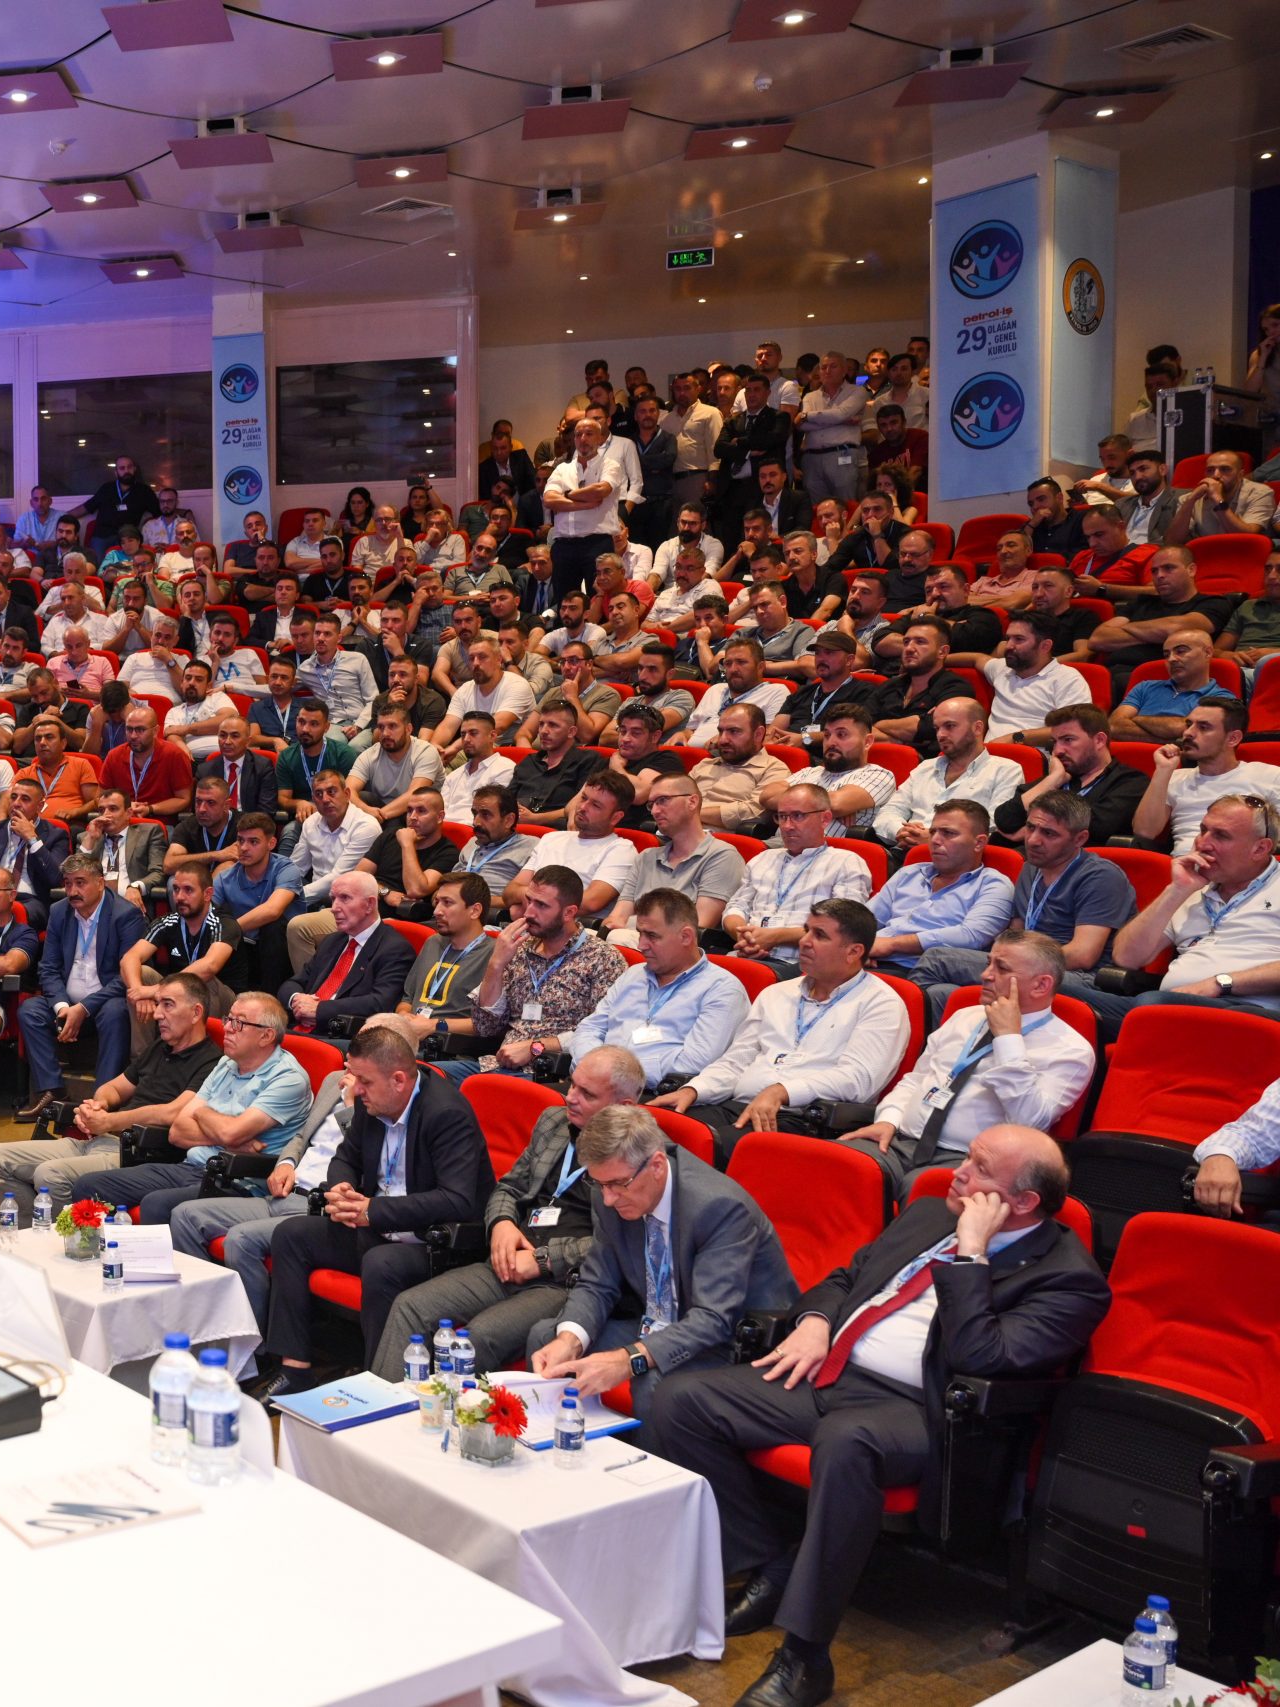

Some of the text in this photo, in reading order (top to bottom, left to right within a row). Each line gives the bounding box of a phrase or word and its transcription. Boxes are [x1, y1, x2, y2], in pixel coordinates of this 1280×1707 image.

[987, 319, 1017, 334] OLAĞAN
[994, 331, 1017, 344] GENEL
[987, 341, 1017, 356] KURULU
